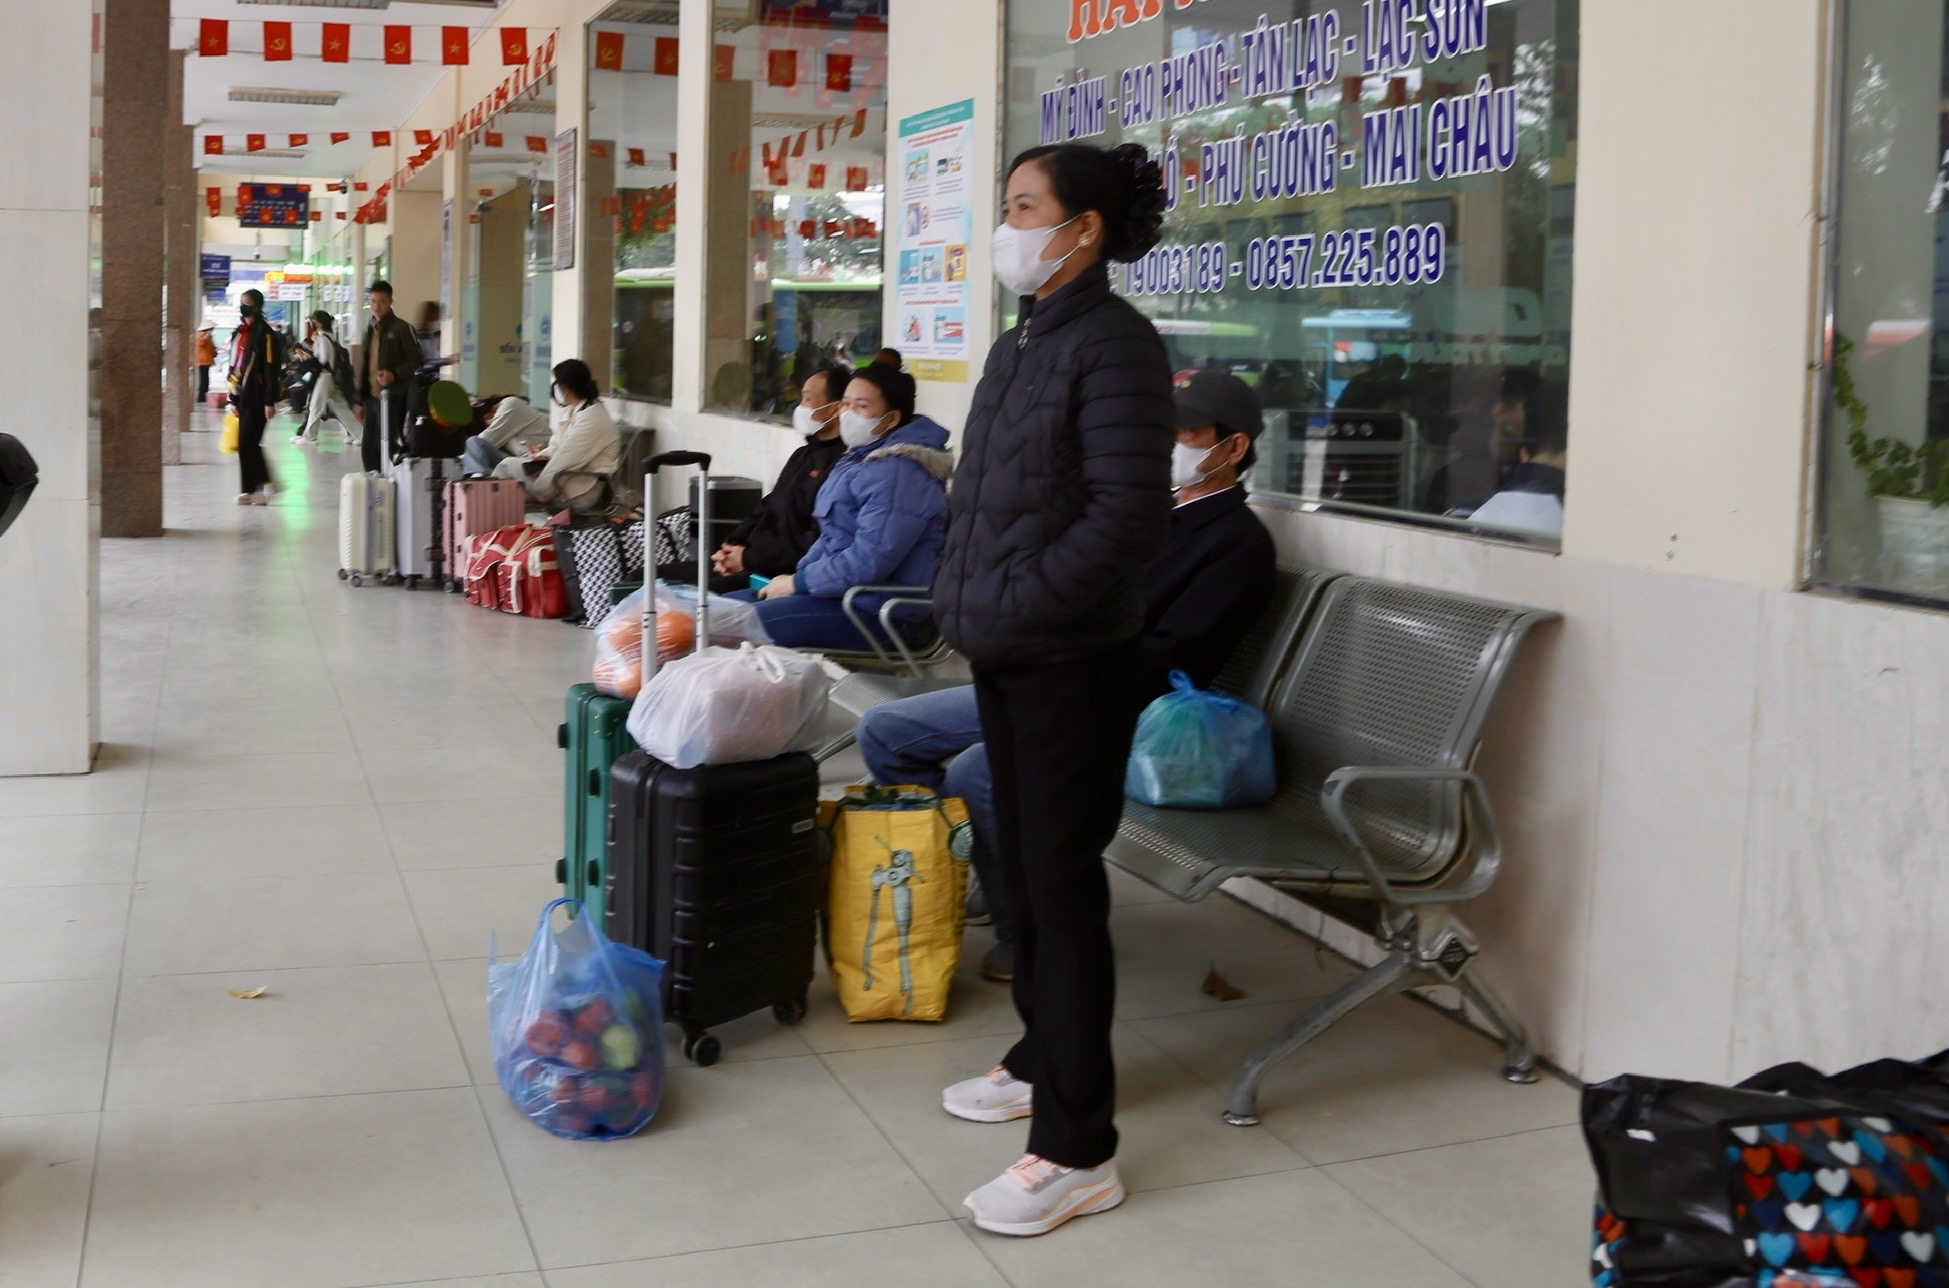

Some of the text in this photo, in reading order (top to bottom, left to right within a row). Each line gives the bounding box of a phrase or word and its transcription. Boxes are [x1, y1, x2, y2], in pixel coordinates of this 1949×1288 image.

[1119, 62, 1155, 130] CAO
[1159, 39, 1228, 122] PHONG
[1241, 12, 1288, 99] TÂN
[1290, 9, 1340, 103] LẠC
[1361, 0, 1416, 86] LẠC
[1199, 122, 1247, 208] PHÚ
[1360, 103, 1422, 189] MAI
[1427, 73, 1519, 180] CHÂU
[1246, 221, 1445, 290] 0857.225.889
